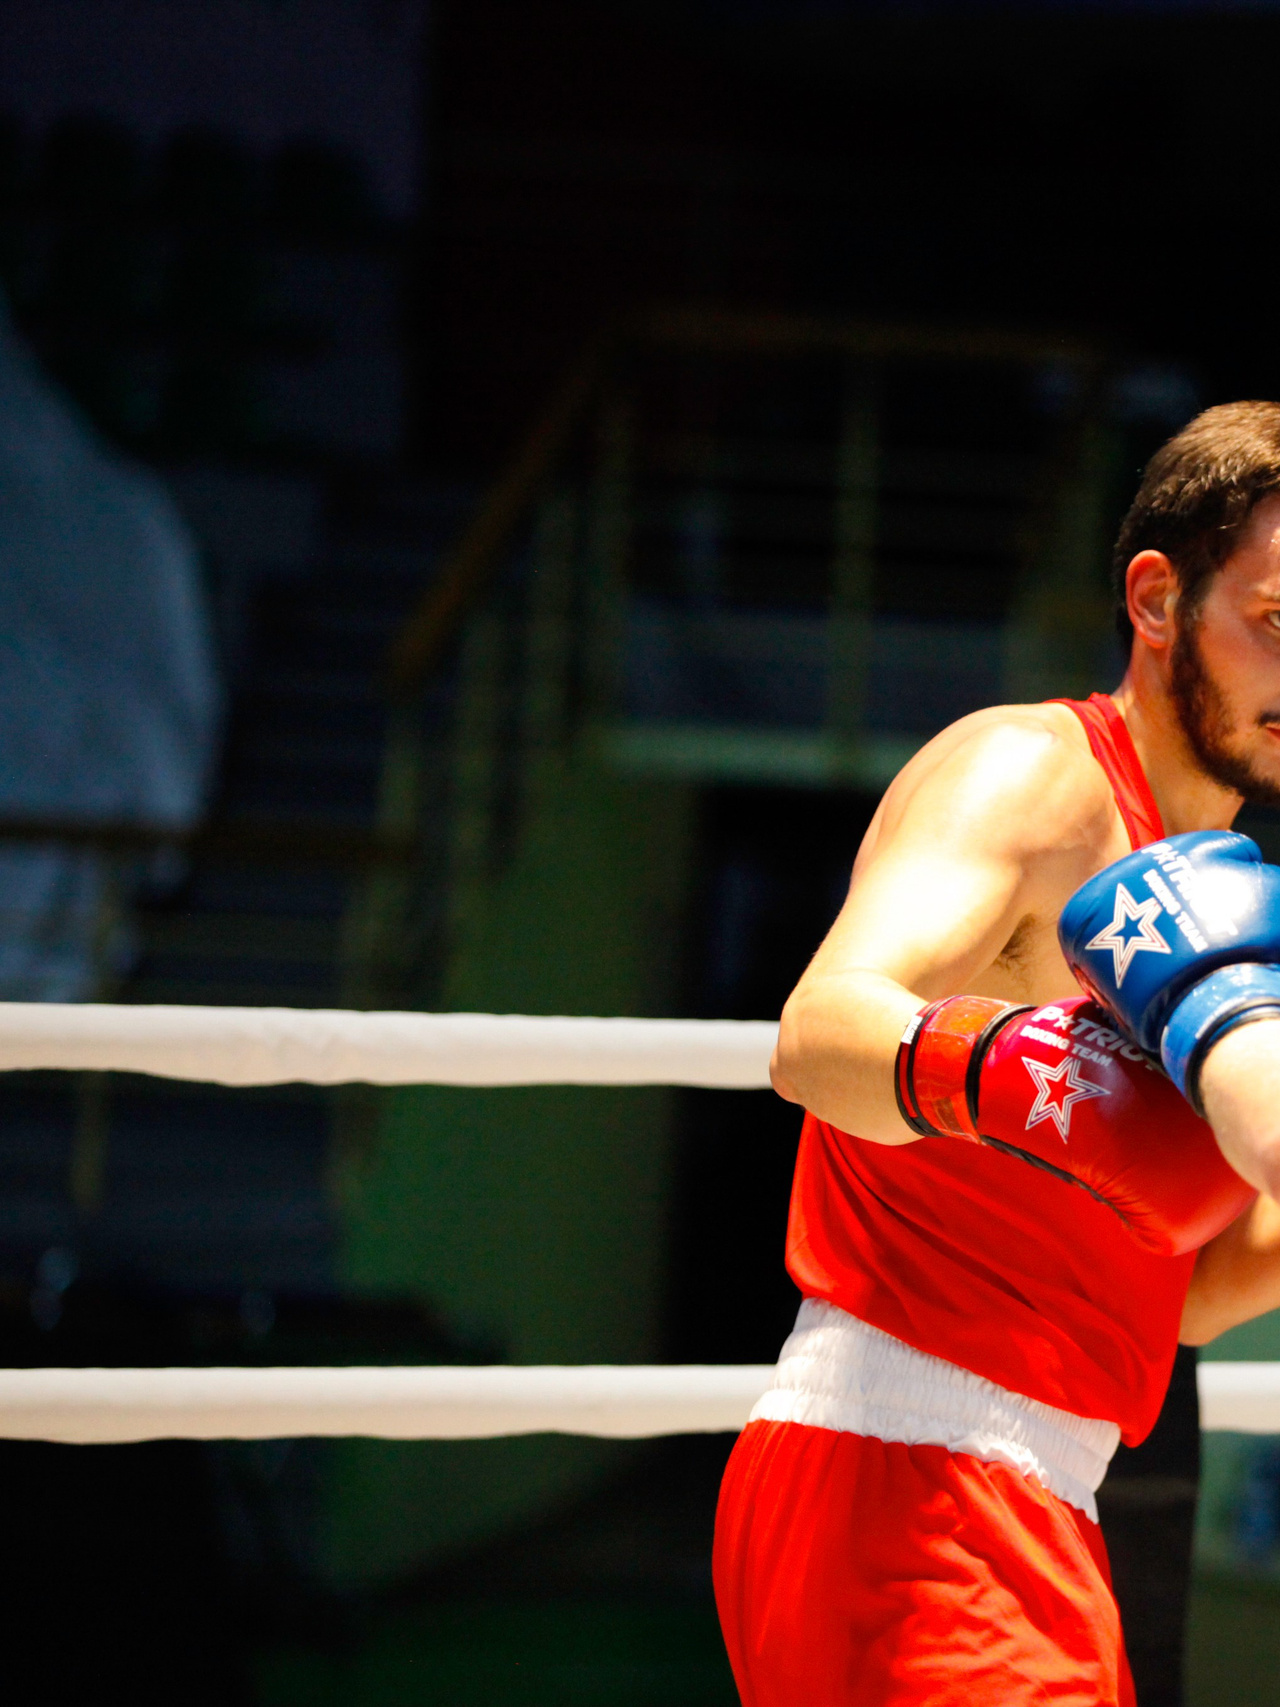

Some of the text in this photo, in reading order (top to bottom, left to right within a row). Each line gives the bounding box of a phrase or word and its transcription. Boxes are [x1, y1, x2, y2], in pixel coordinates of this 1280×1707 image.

[1142, 868, 1209, 954] BOXING TEAM
[1019, 1024, 1114, 1068] BOXING TEAM
[1030, 1006, 1153, 1071] PTRIO
